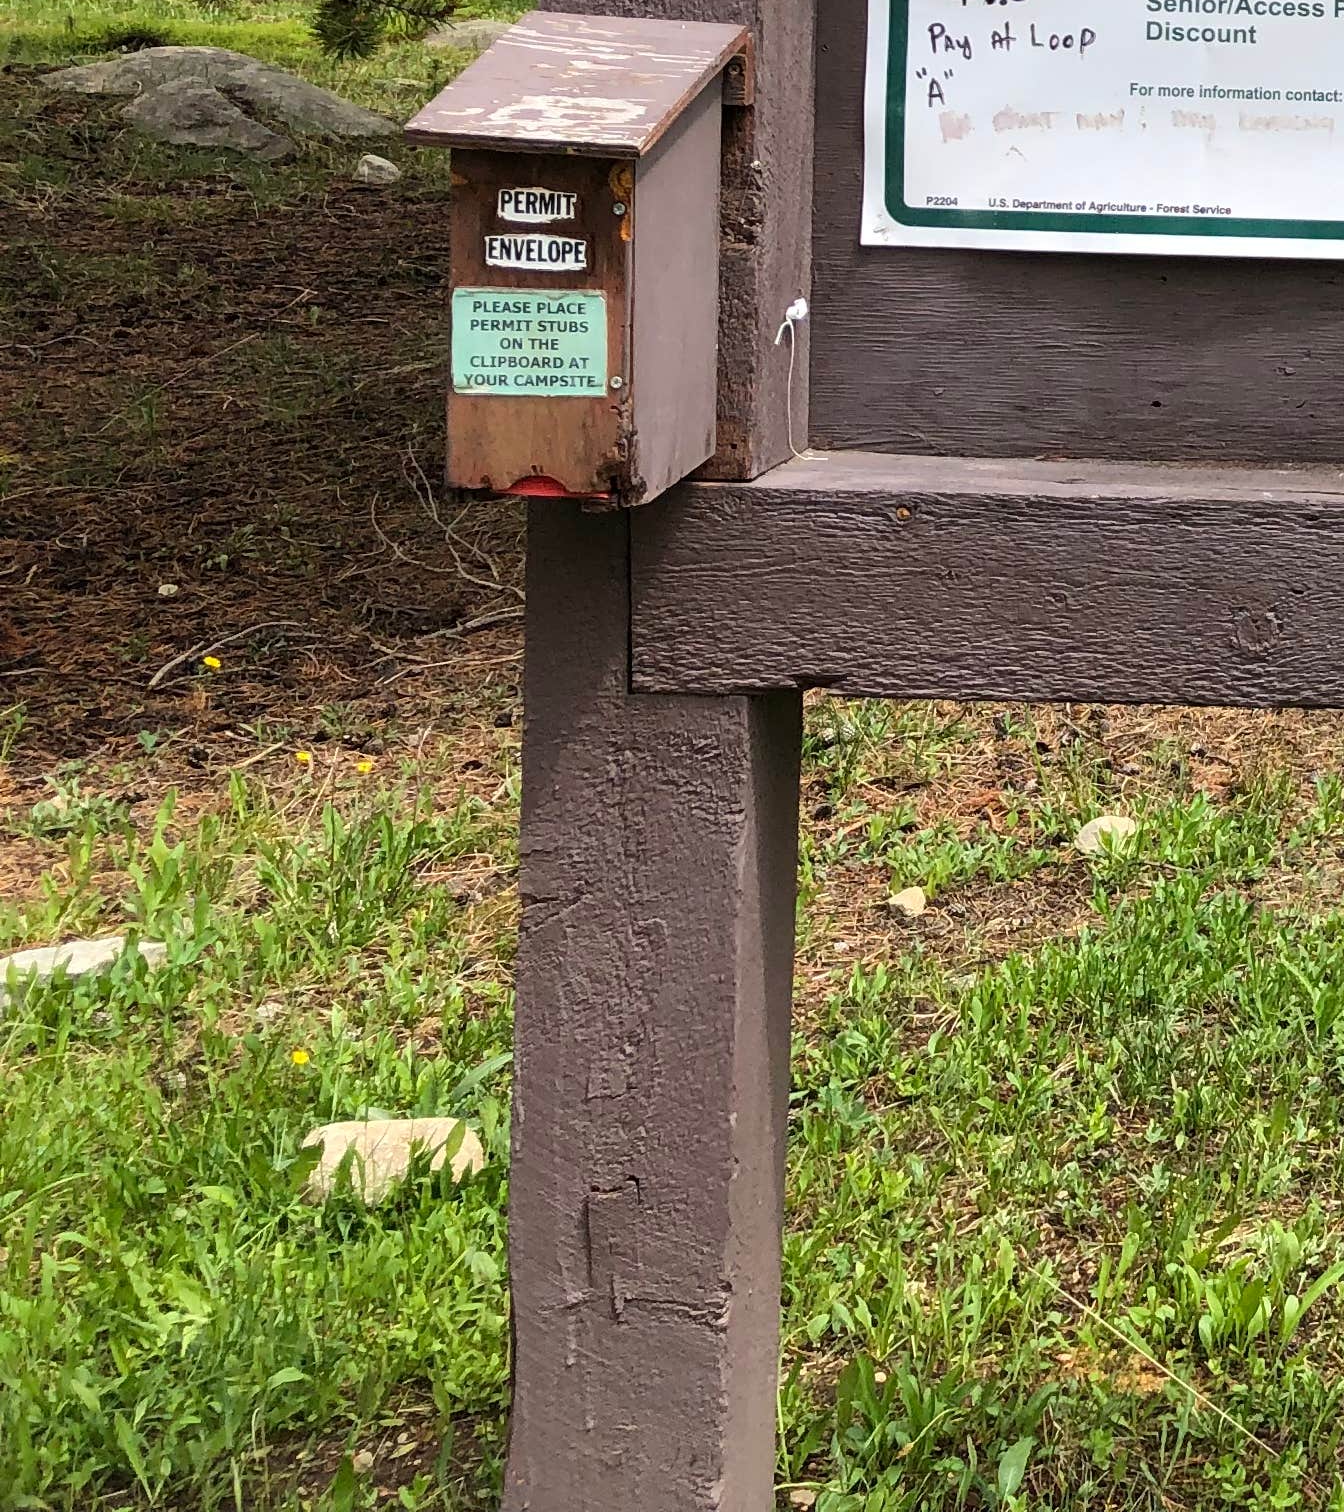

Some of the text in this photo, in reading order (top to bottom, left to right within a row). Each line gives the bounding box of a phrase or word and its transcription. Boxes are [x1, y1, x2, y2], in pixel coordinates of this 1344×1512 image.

[1146, 20, 1257, 44] Discount
[1130, 83, 1343, 103] For more information contact:
[500, 191, 575, 215] PERMIT
[926, 197, 958, 206] P2204
[488, 238, 585, 263] ENVELOPE
[473, 301, 586, 315] PLEASE PLACE
[470, 320, 589, 332] PERMIT STUBS
[500, 338, 559, 350] ON THE
[470, 356, 589, 369] CLIPBOARD AT
[464, 374, 595, 387] YOUR CAMPSITE
